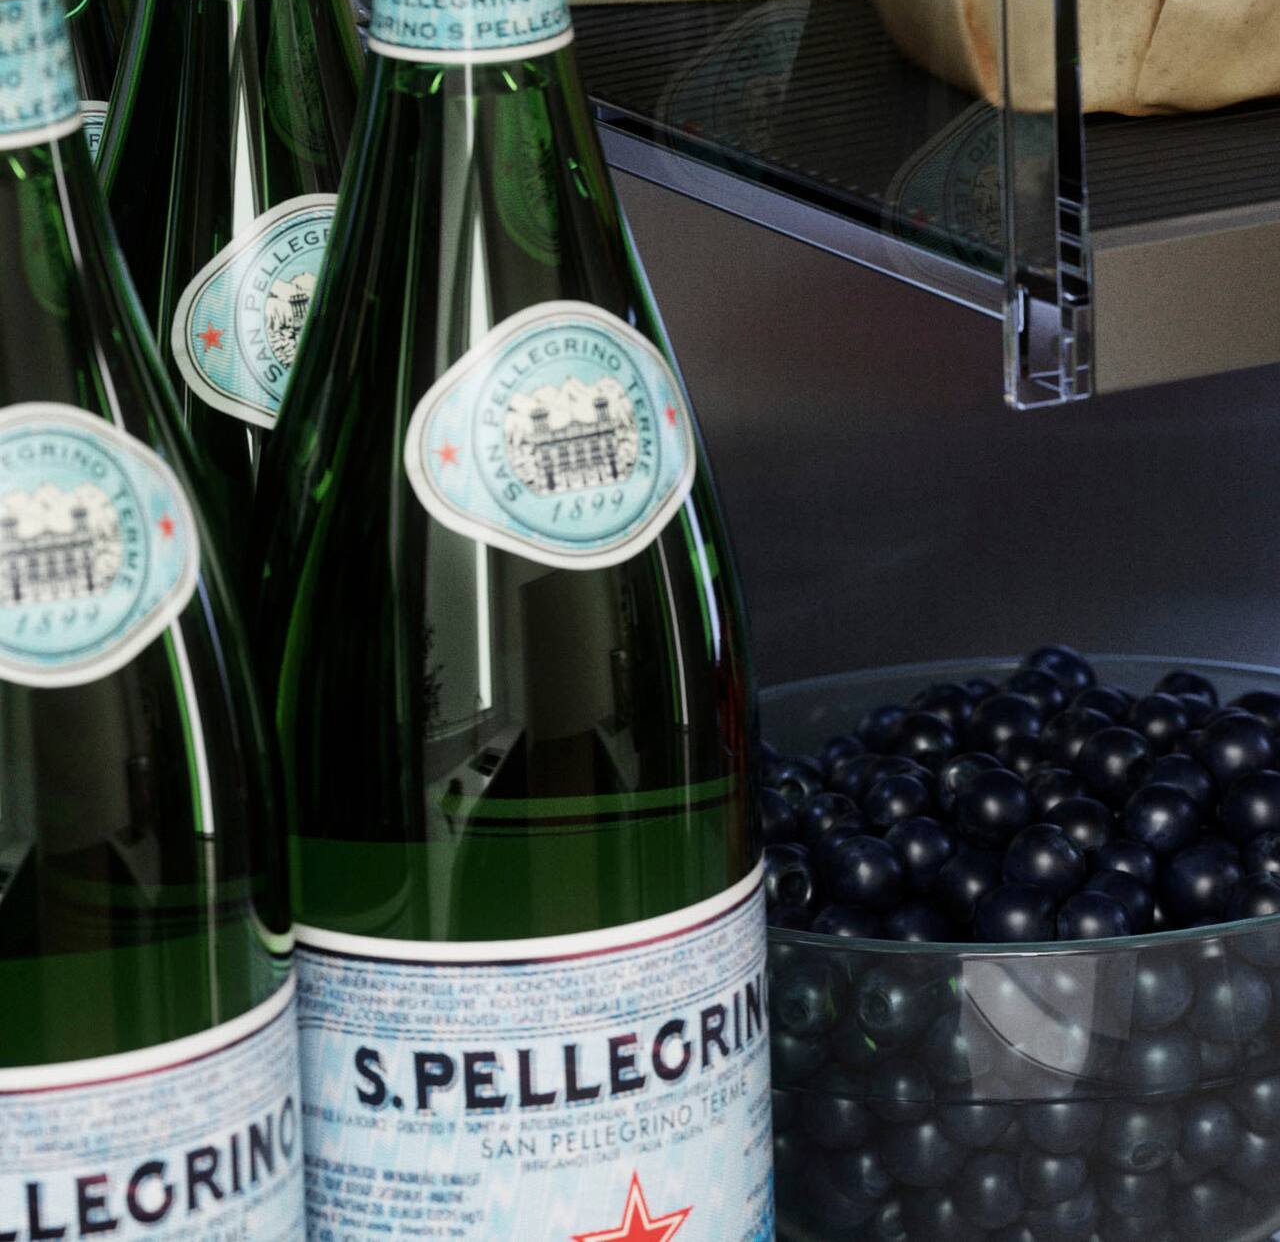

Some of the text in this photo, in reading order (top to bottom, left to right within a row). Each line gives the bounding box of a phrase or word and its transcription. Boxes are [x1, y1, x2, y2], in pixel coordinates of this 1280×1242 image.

[481, 335, 623, 429] PELLEGRINO
[486, 441, 525, 504] SAN
[354, 972, 768, 1111] S.PELLEGRIN
[0, 1095, 297, 1242] LEGRINO
[481, 1137, 539, 1159] SAN
[549, 1104, 693, 1155] PELLEGRINO
